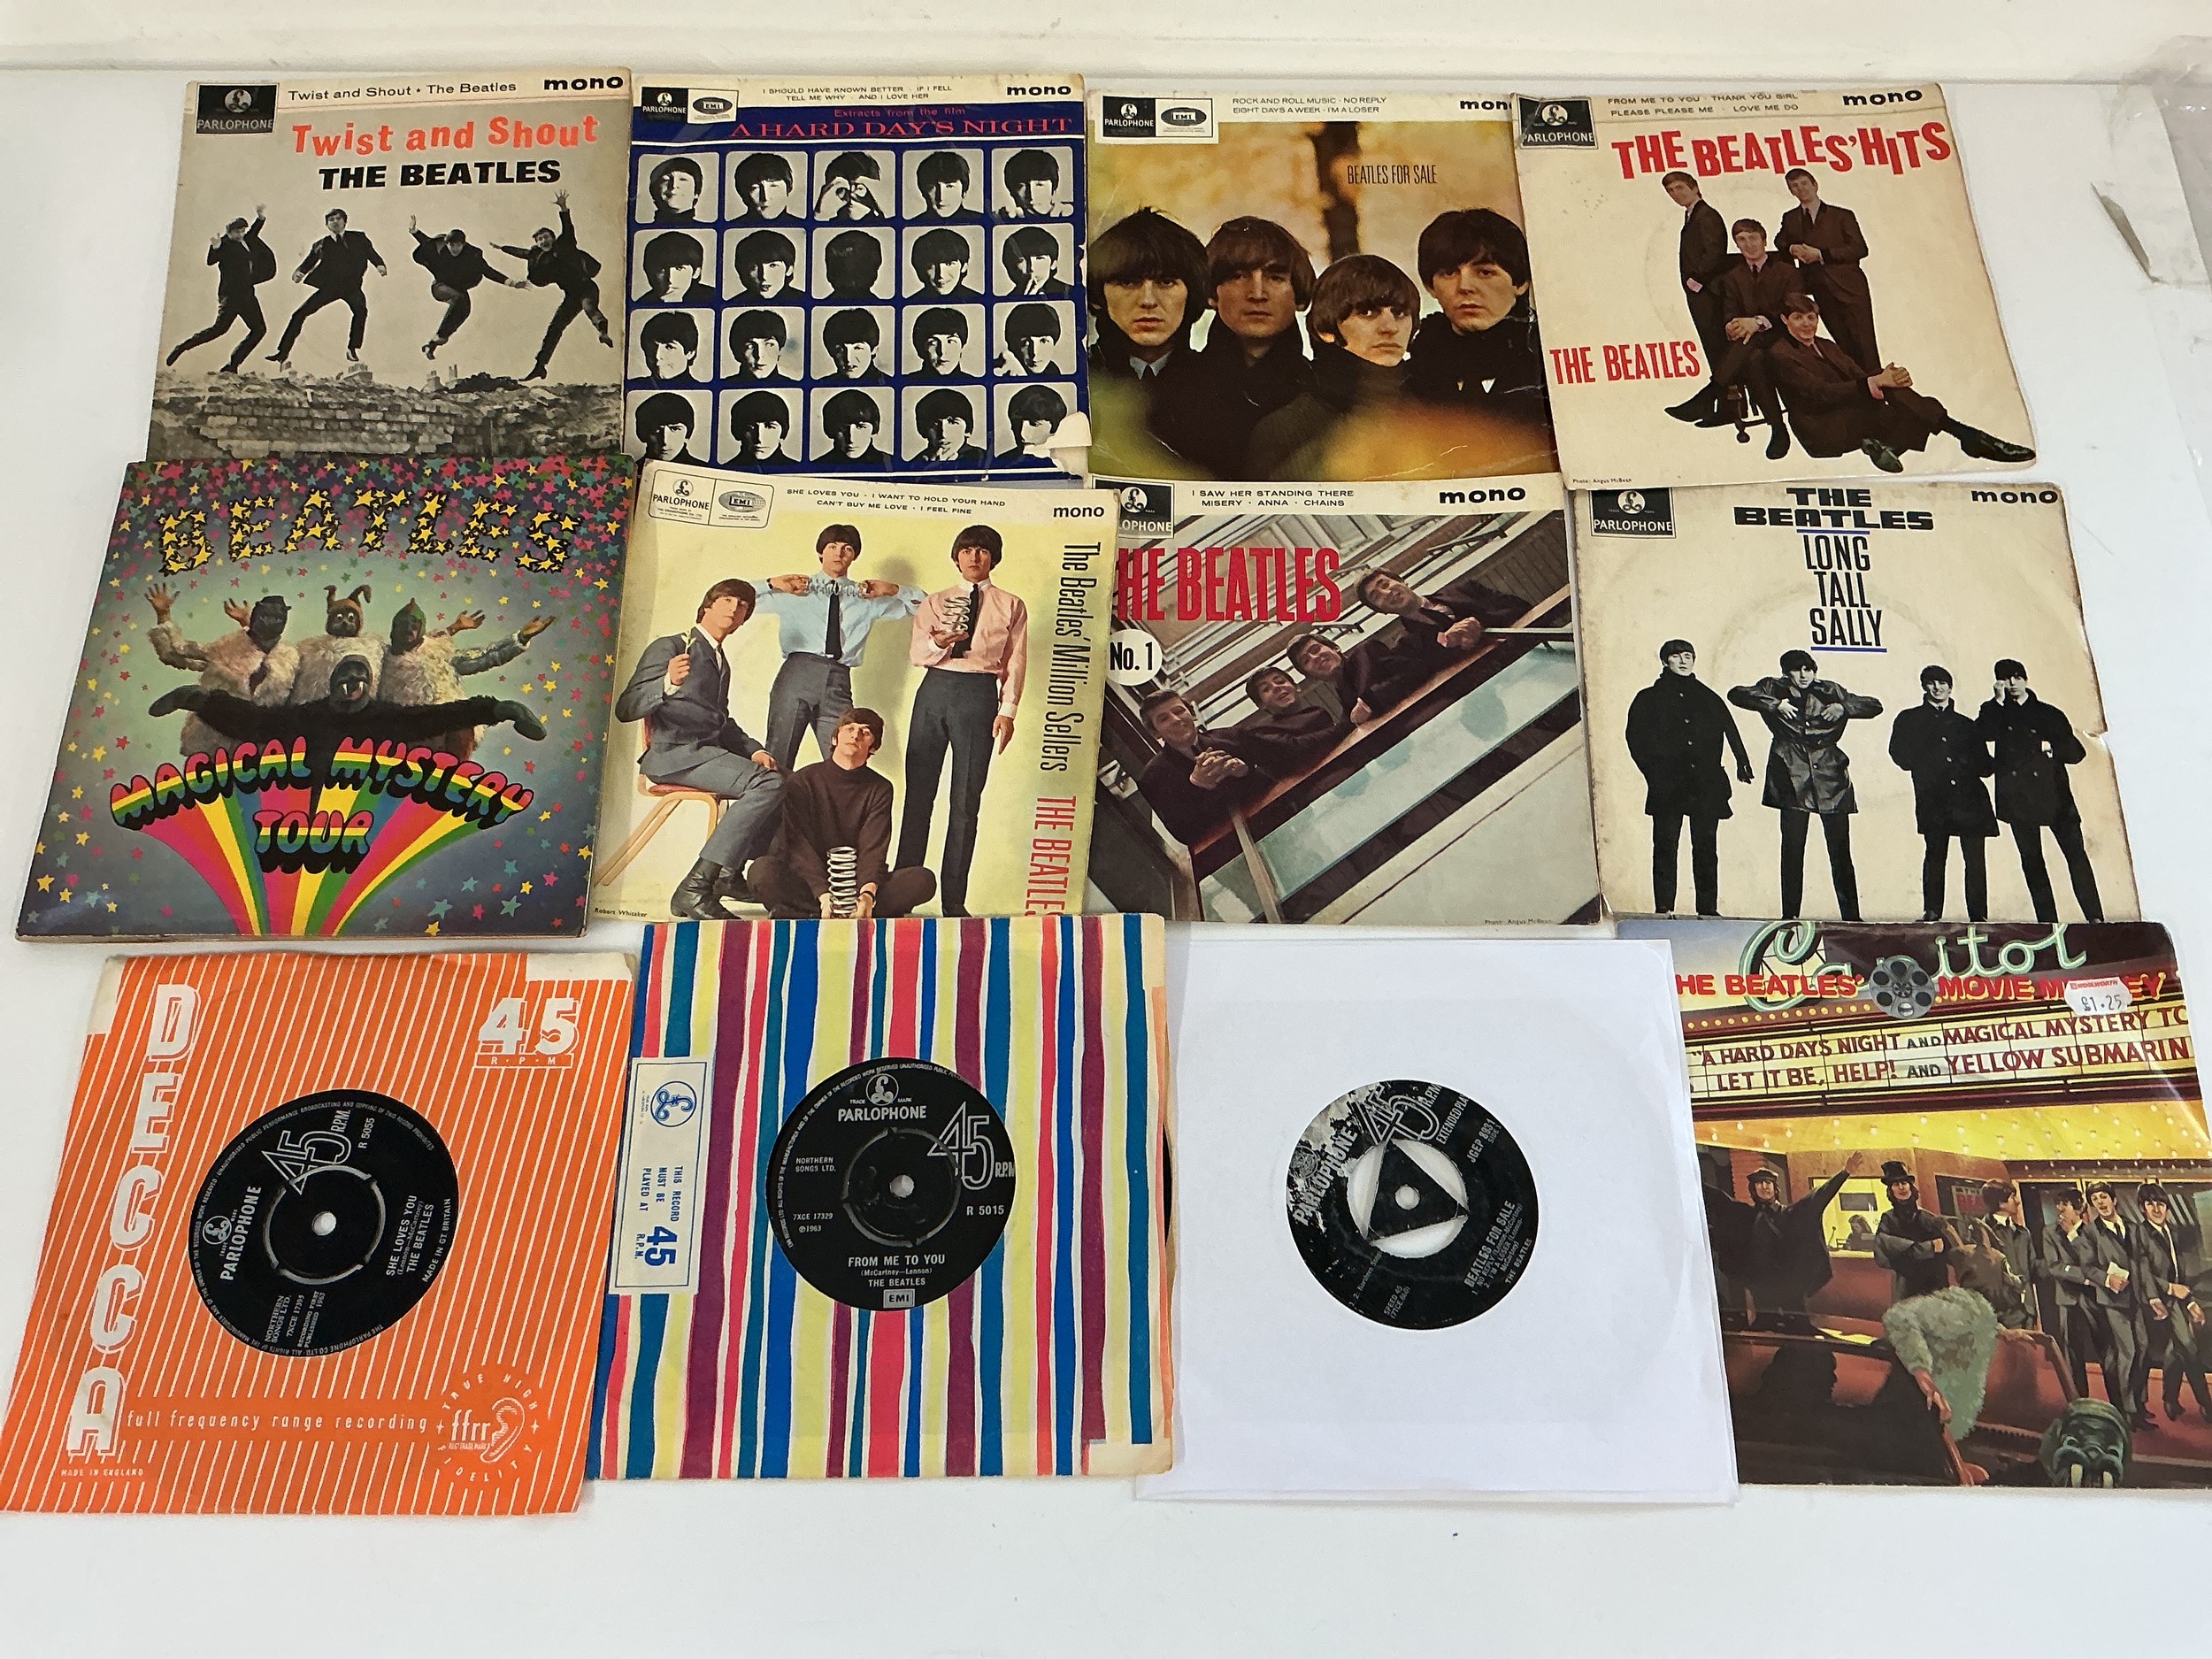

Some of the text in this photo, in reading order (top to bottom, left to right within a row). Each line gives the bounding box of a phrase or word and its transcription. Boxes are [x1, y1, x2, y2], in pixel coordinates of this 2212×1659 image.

[288, 82, 516, 101] Twist and Shout The Beatles
[544, 76, 623, 90] mono
[1007, 86, 1071, 96] mono
[1842, 90, 1922, 106] mono
[196, 119, 273, 130] PARLOPHONE
[642, 105, 687, 114] PARLOPHONE
[834, 107, 965, 118] Extracts from the film
[1104, 119, 1154, 127] PARLOPHONE
[292, 115, 598, 156] Twist and Shout
[731, 119, 1072, 137] A HARD DAY'S NIGHT
[1611, 130, 1688, 180] THE
[1856, 121, 1951, 175] HITS
[319, 160, 561, 189] THE BEATLES
[1347, 165, 1437, 184] BEATLES FOR SALE
[1549, 341, 1701, 385] THE BEATLES
[653, 494, 710, 511] PARLOPHONE
[1440, 487, 1526, 504] mono
[1786, 487, 1872, 508] THE
[1970, 489, 2058, 504] mono
[1053, 506, 1105, 518] mono
[1594, 518, 1672, 532] PARLOPHONE
[1733, 506, 1934, 531] BEATLES
[159, 488, 582, 576] BEATLES
[1803, 534, 1870, 572] LONG
[1178, 547, 1341, 622] BEATLES
[1814, 571, 1871, 608] TALL
[1809, 608, 1883, 647] SALLY
[1040, 541, 1101, 772] The Beatles' Million Sellers
[1110, 641, 1153, 671] No. 1
[109, 726, 534, 829] MAGICAL MYSTERY
[254, 810, 374, 872] TOUR
[1025, 795, 1076, 917] THE BEATLE
[1725, 973, 2037, 1003] BEATLES' MOVIE
[479, 997, 580, 1055] 45
[1720, 1010, 2149, 1064] HARD DAYS NIGHT AND MAGICAL MYSTERY
[1717, 1048, 2045, 1091] LET IT BE, HELP! AND YELLOW
[361, 1118, 375, 1139] 5055
[838, 1105, 927, 1122] PARLOPHONE
[1436, 1107, 1462, 1145] EXTENDED
[1479, 1118, 1496, 1140] 8931
[927, 1101, 995, 1191] 45
[261, 1130, 351, 1194] 45
[641, 1168, 651, 1197] PLAYED
[656, 1167, 667, 1202] MUST BE
[671, 1166, 683, 1222] THIS RECORD
[66, 982, 201, 1457] DECCA
[966, 1205, 1005, 1216] R 5015
[220, 1186, 262, 1280] PARLOPHONE
[387, 1195, 417, 1276] SHE LOVES YOU
[406, 1204, 434, 1272] THE BEATLES
[645, 1225, 678, 1267] 45
[1464, 1201, 1516, 1287] BEATLES FOR SALE
[849, 1254, 946, 1267] FROM ME TO YOU
[1505, 1238, 1532, 1284] THE BEATLES
[868, 1278, 926, 1287] THE BEATLES
[127, 1409, 427, 1433] full frequency range recording
[451, 1409, 491, 1441] ffrr
